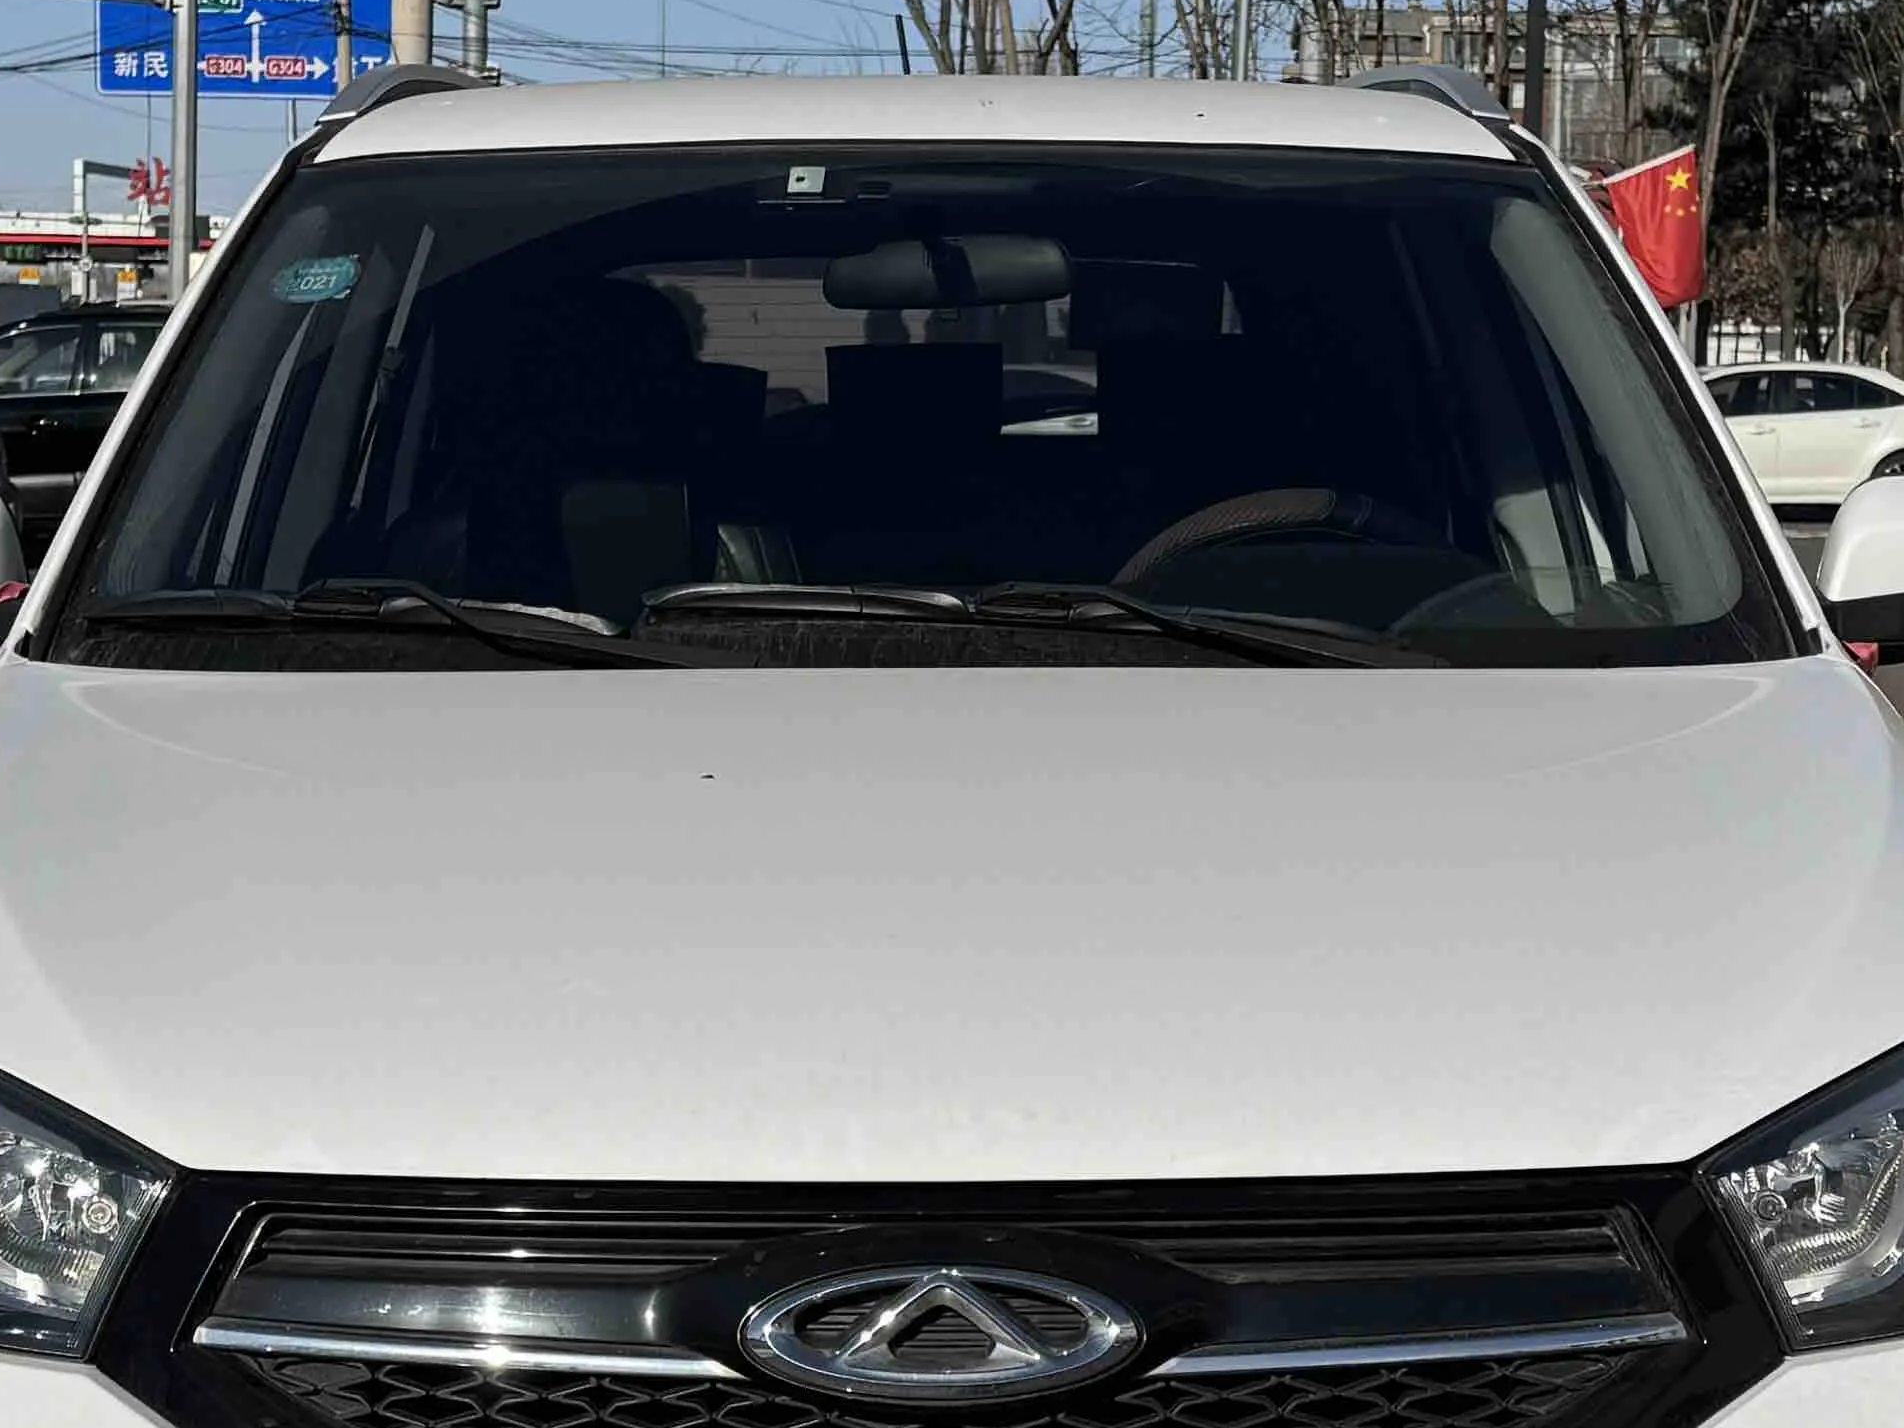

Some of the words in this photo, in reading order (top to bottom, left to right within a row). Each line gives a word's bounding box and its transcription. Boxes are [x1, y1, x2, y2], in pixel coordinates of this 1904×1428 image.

[114, 51, 169, 78] 新民
[267, 58, 304, 76] G304
[5, 245, 35, 260] ETC
[287, 274, 337, 291] 2021
